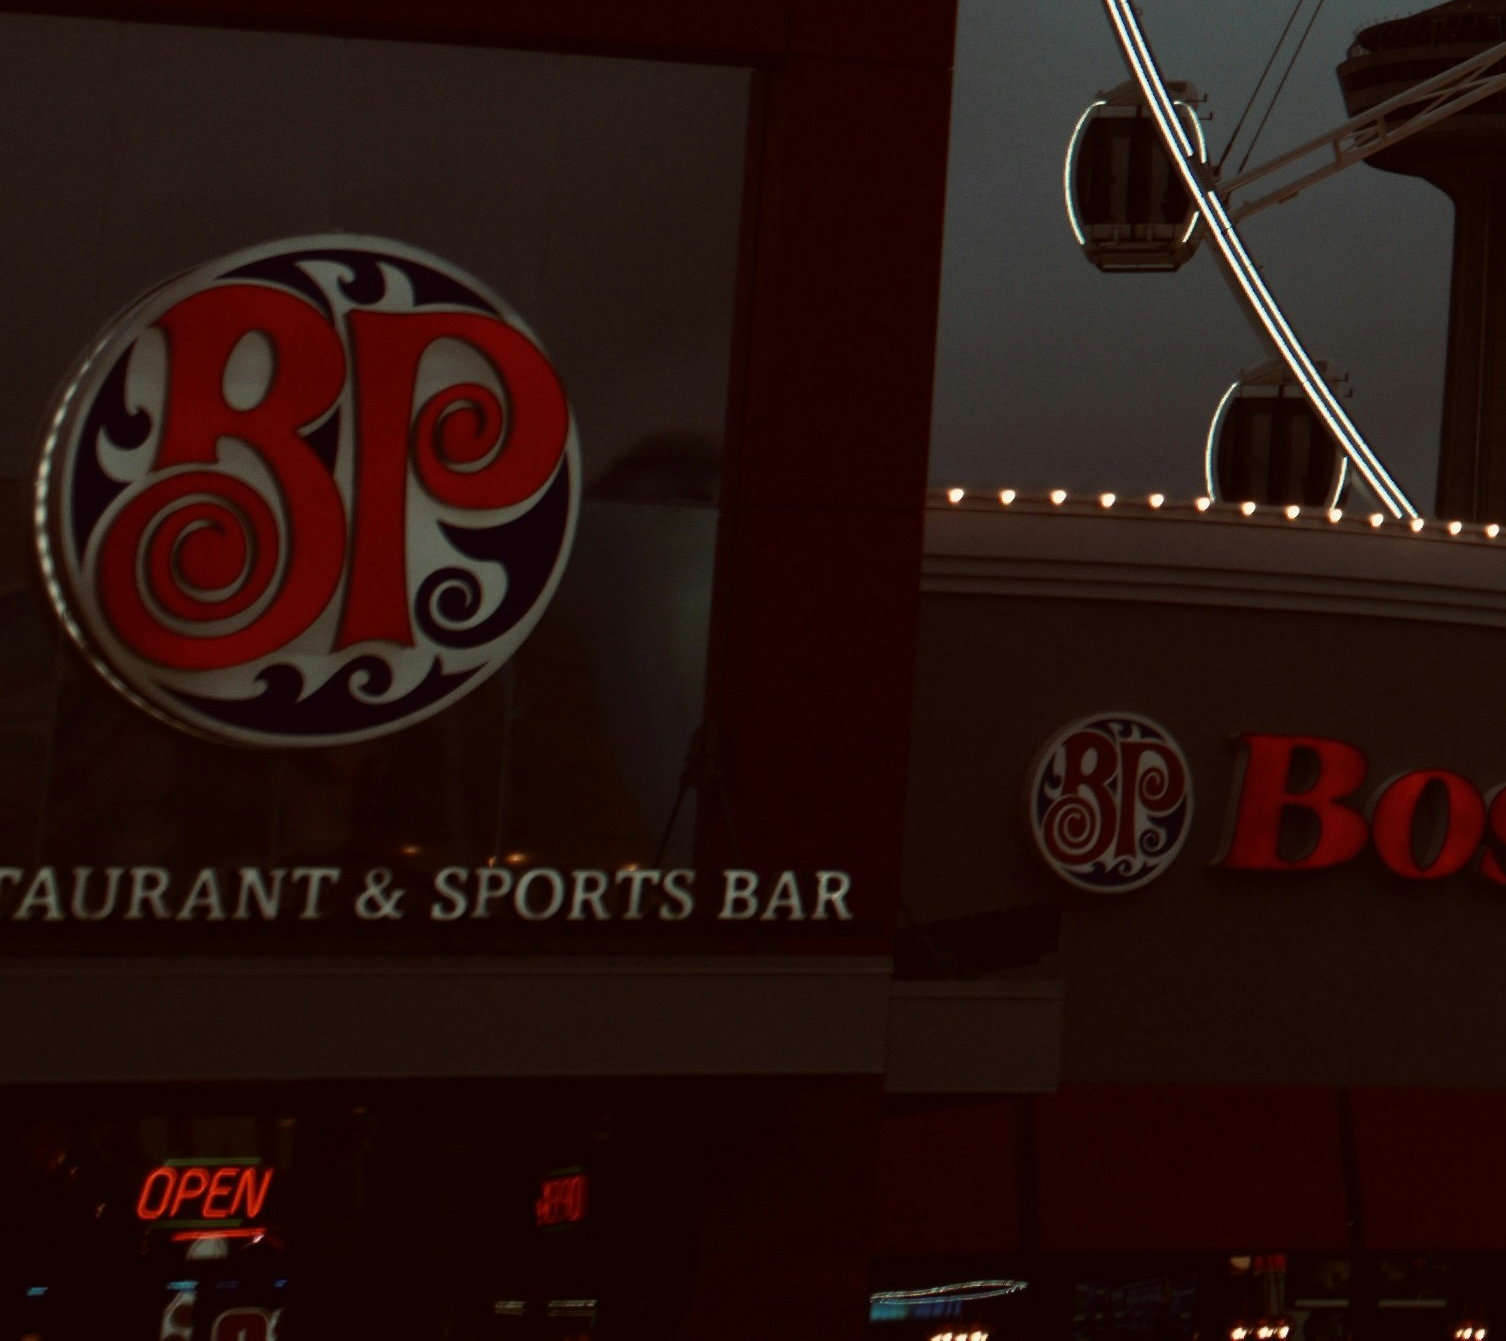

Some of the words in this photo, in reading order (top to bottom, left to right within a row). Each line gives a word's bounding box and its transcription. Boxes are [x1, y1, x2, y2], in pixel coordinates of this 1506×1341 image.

[354, 865, 408, 922] &
[430, 865, 697, 922] SPORTS
[718, 867, 856, 922] BAR
[137, 1167, 276, 1221] OPEN
